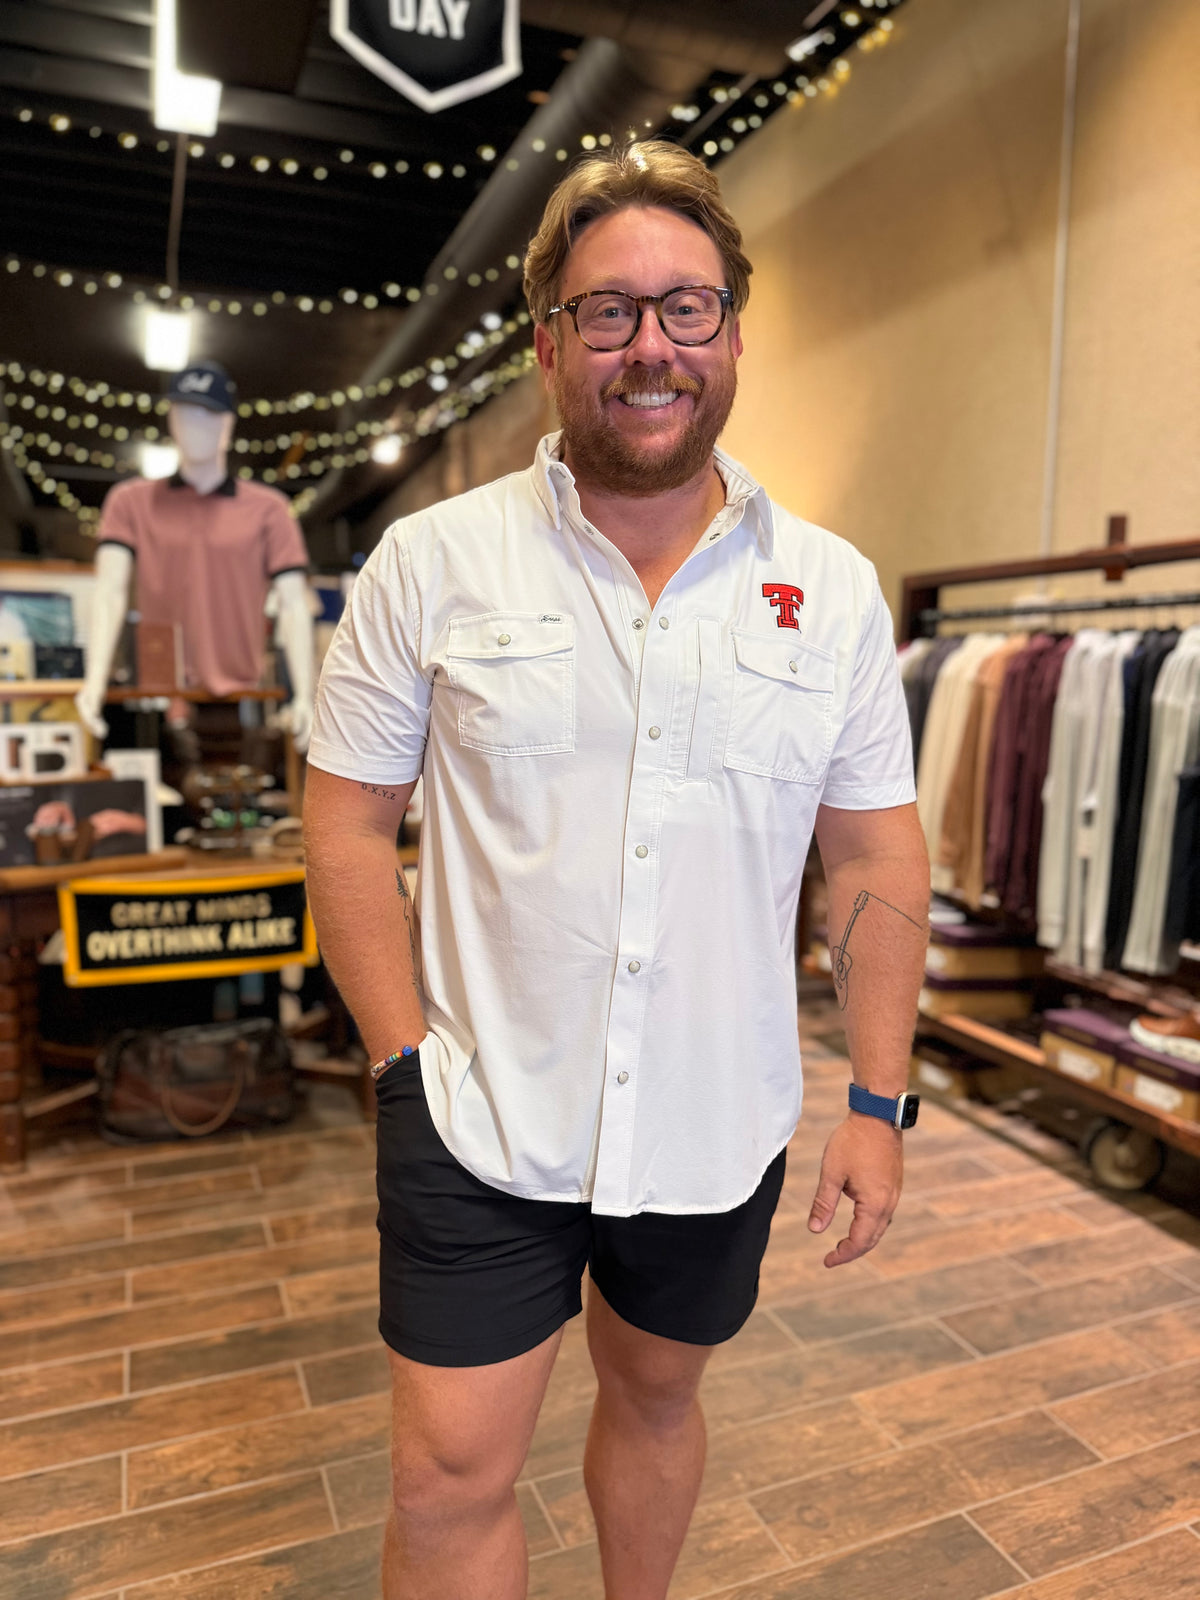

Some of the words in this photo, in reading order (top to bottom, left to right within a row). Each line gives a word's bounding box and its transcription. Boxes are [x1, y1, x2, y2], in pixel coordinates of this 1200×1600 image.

[111, 901, 191, 927] GREAT
[196, 893, 272, 922] MINDS
[86, 924, 223, 961] OVERTHINK
[227, 917, 296, 949] ALIKE
